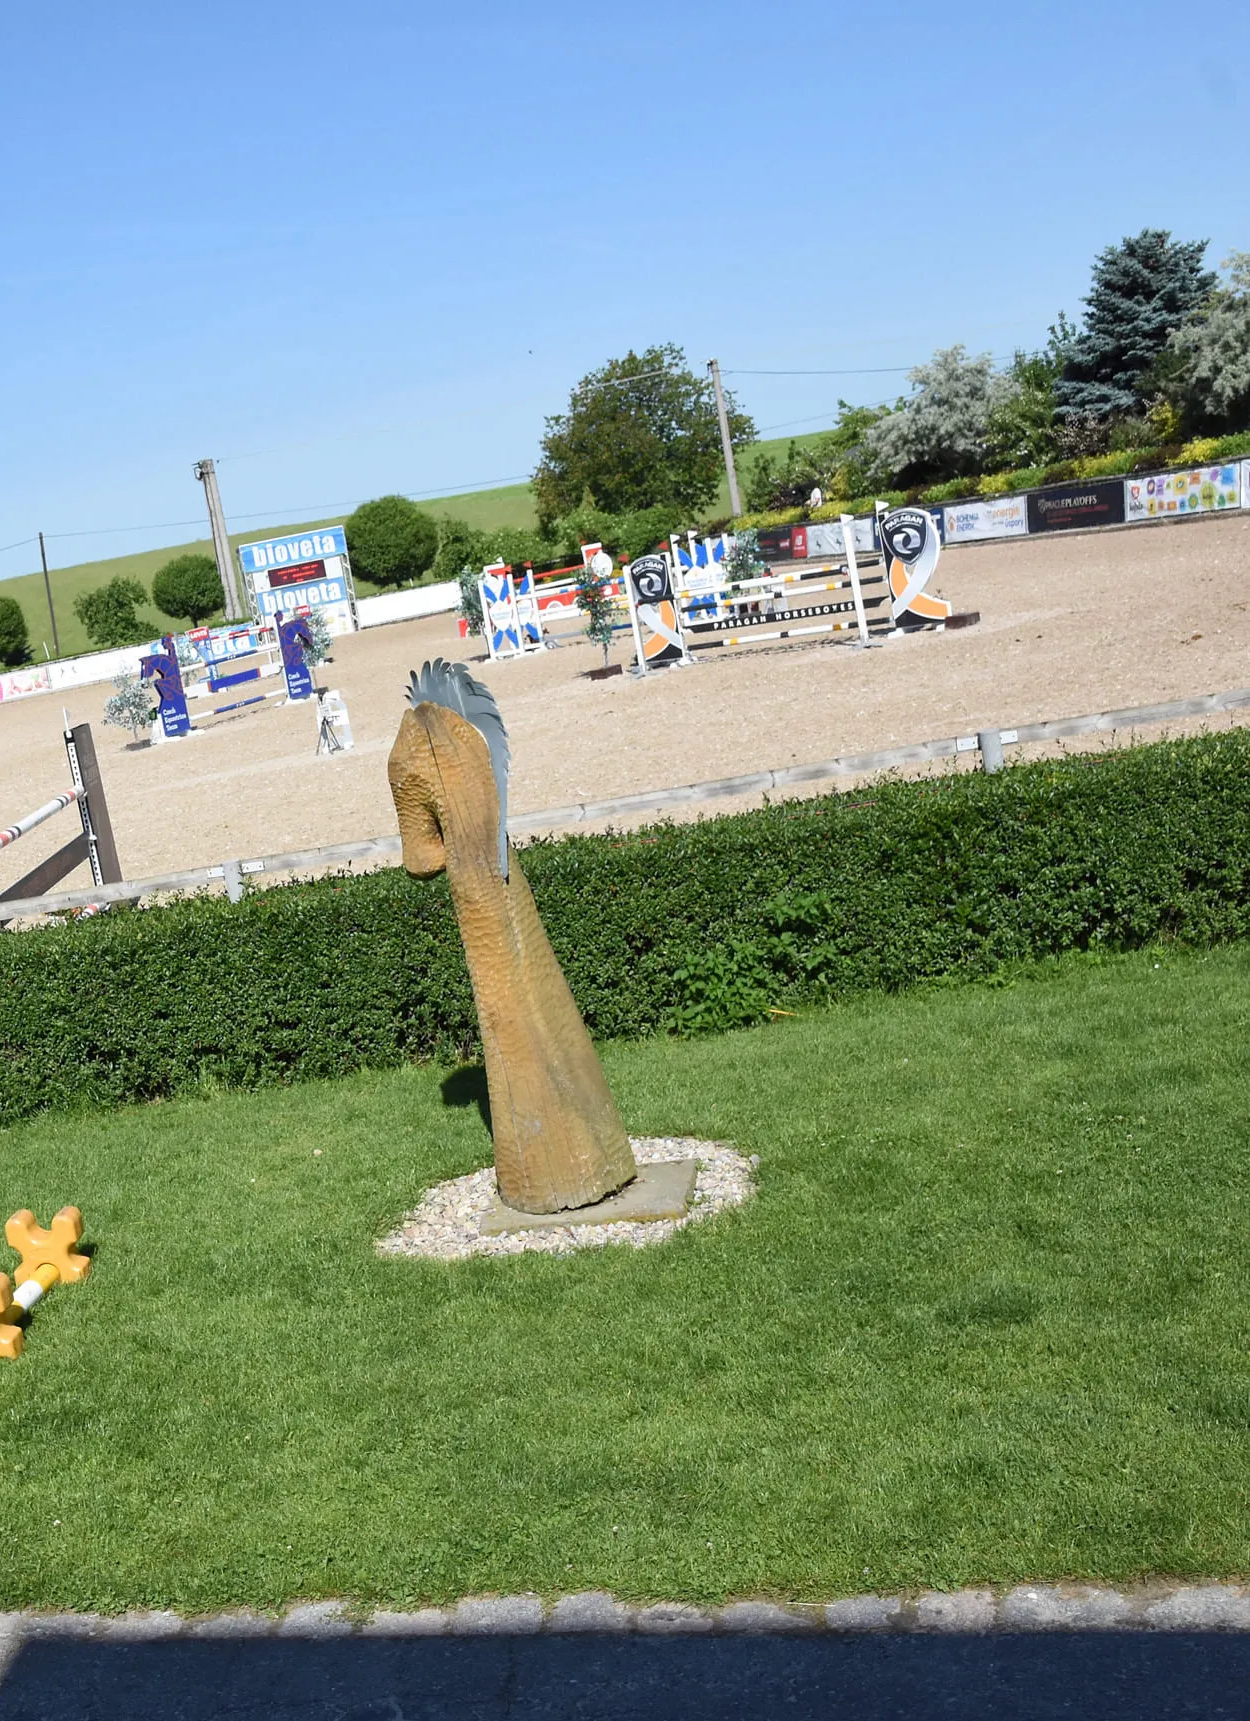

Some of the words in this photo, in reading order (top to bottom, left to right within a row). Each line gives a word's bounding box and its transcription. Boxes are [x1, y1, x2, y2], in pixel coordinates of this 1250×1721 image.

[885, 515, 924, 530] PARAGAN
[252, 535, 336, 567] bioveta
[262, 582, 342, 613] bioveta
[713, 615, 767, 630] PARAGAN
[776, 602, 854, 620] HORSEBOXES
